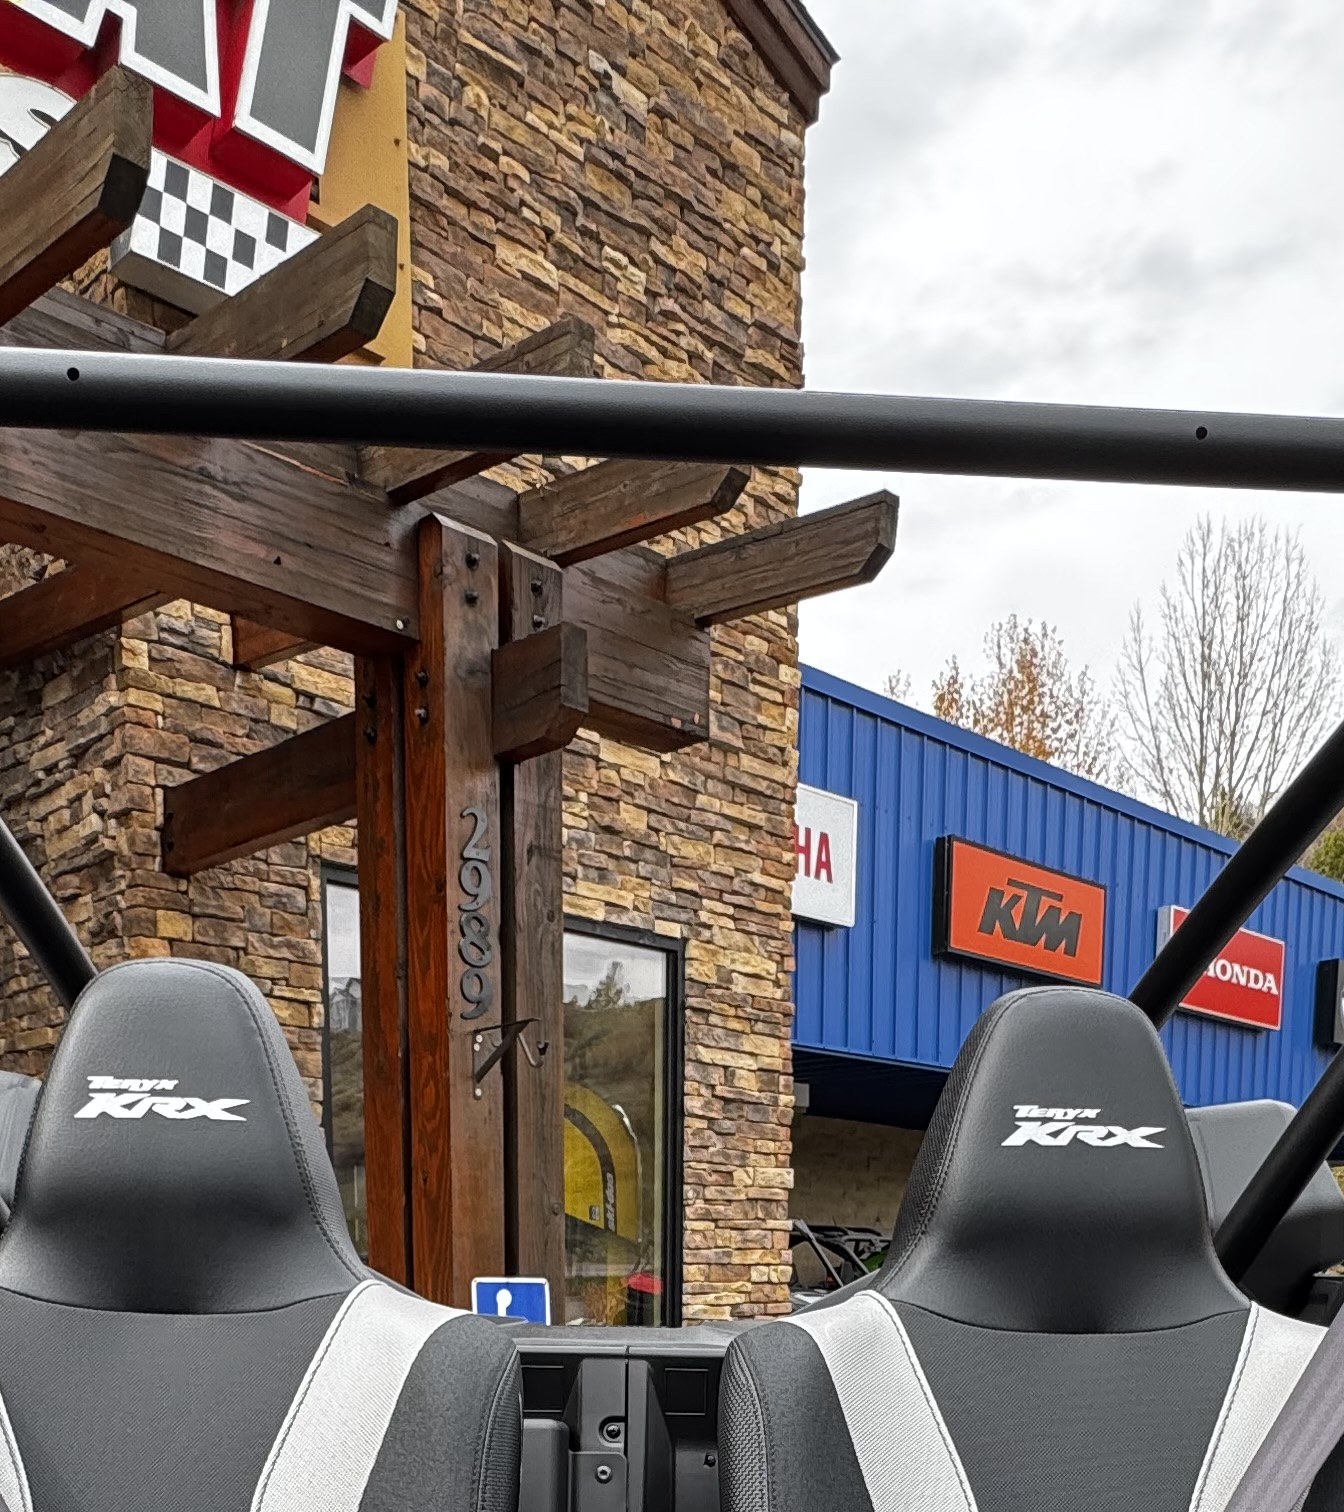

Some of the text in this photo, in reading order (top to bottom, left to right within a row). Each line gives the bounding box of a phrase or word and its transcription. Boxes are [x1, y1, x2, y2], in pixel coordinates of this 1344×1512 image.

[458, 807, 492, 1020] 2989
[977, 877, 1083, 958] KTM
[73, 1093, 251, 1121] KRX
[1001, 1122, 1167, 1148] KRX
